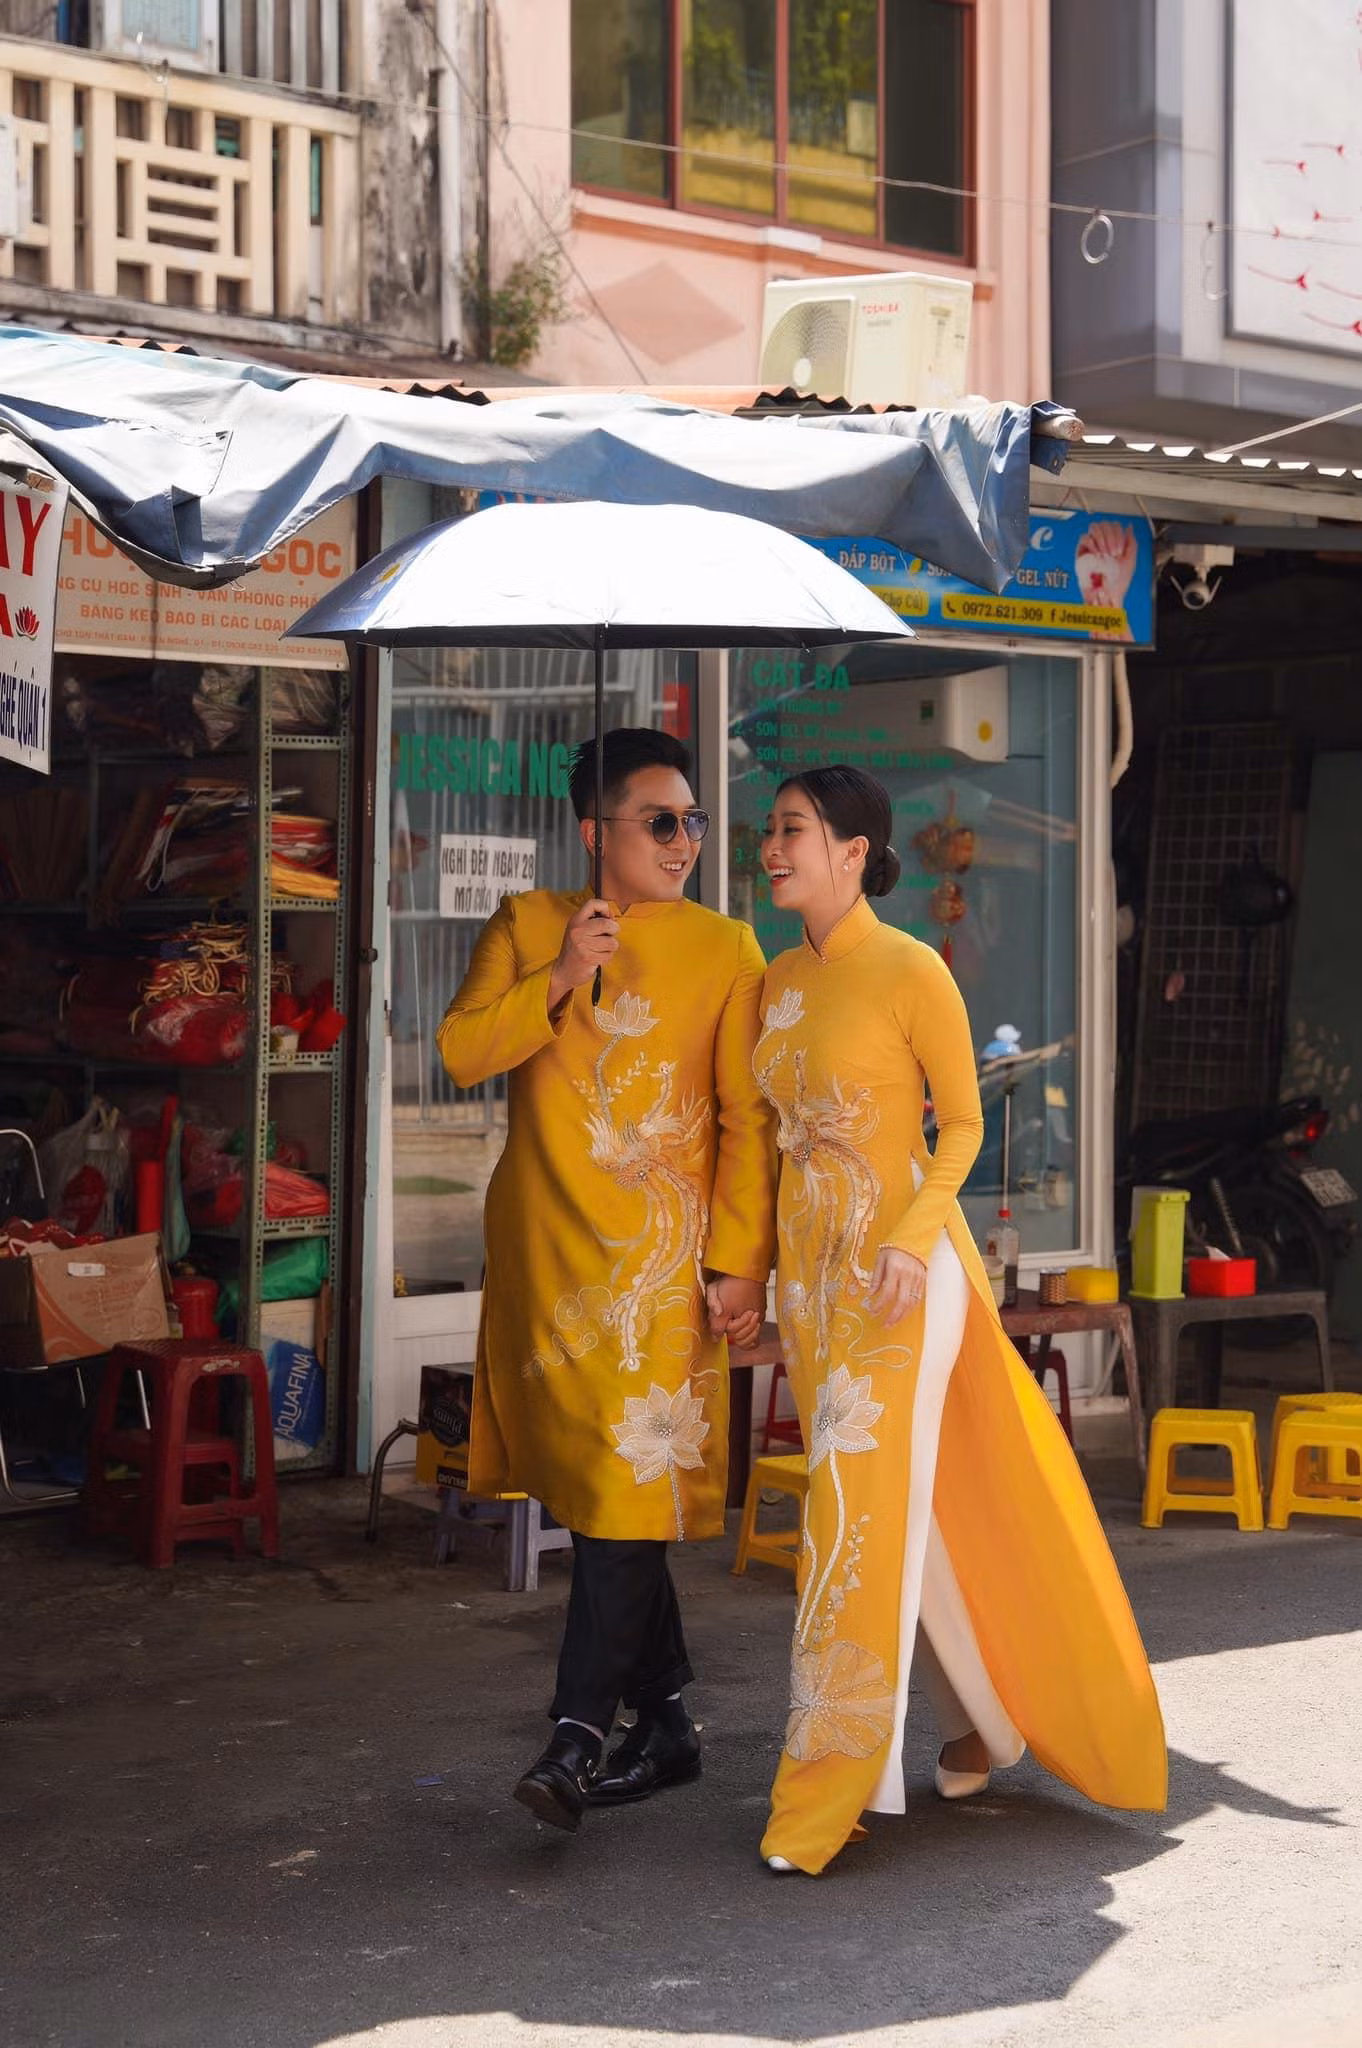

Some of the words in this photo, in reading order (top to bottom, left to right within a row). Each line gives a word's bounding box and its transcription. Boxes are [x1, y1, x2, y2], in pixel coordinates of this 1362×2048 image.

[1016, 568, 1041, 586] GEL
[395, 735, 523, 797] JESSICA
[274, 1353, 315, 1441] AQUAFINA
